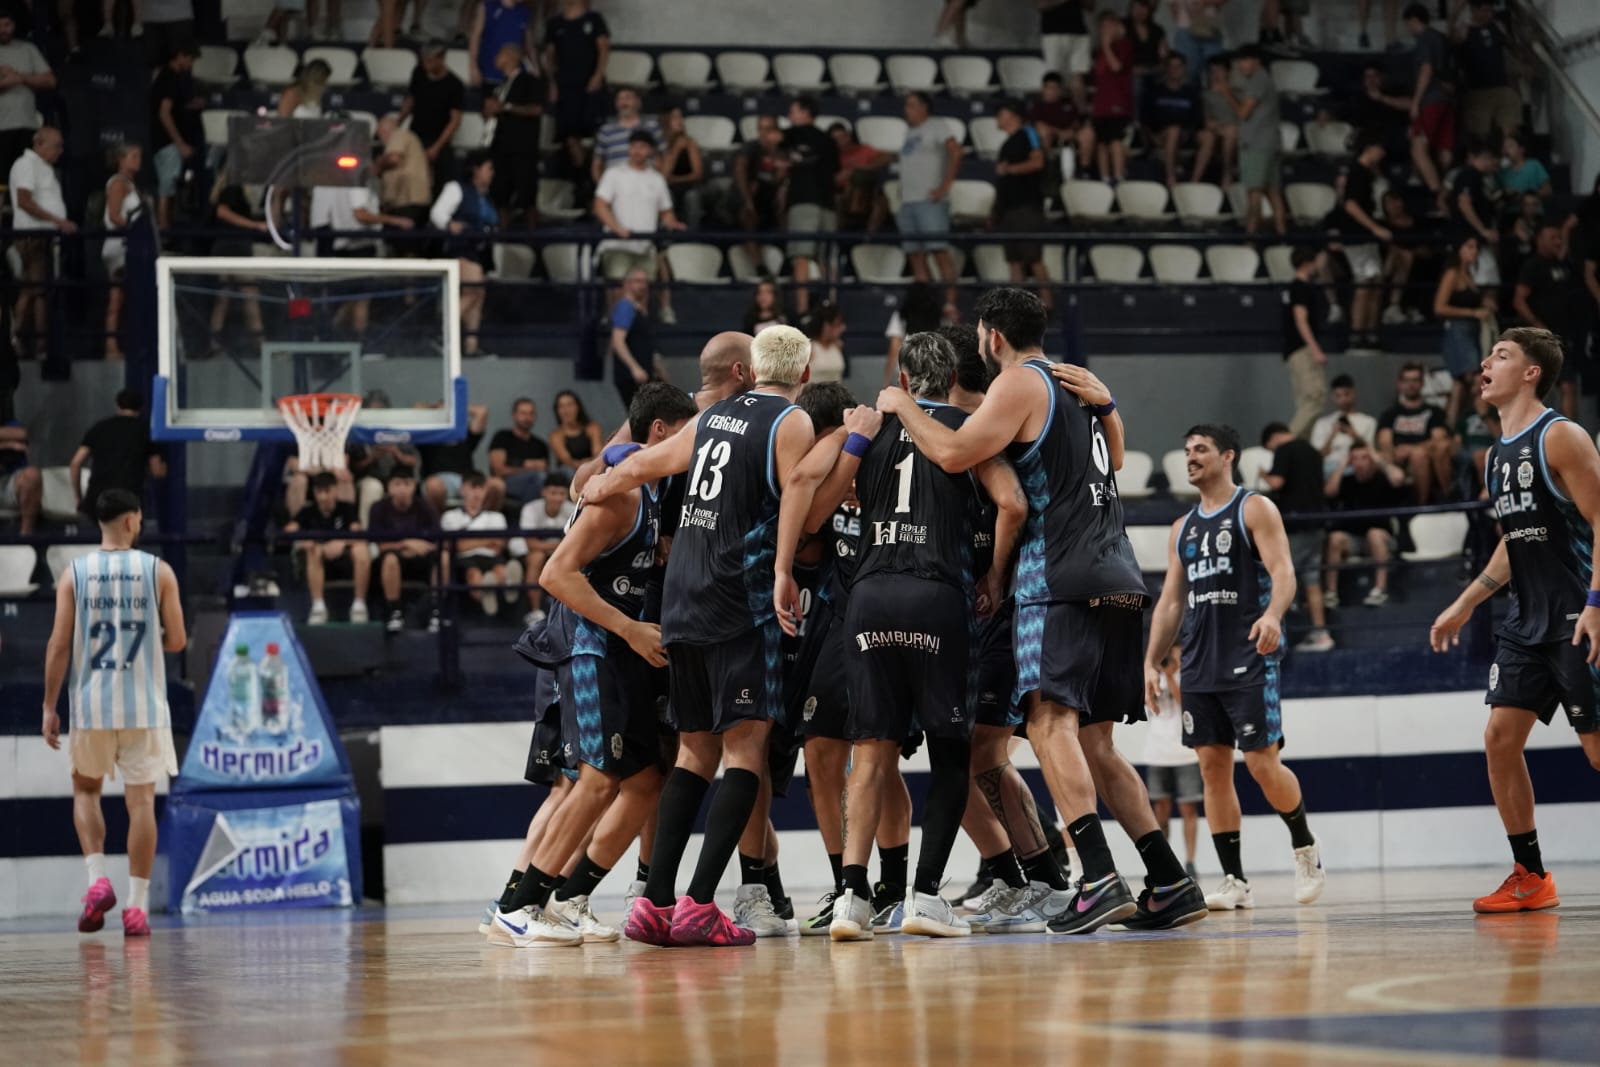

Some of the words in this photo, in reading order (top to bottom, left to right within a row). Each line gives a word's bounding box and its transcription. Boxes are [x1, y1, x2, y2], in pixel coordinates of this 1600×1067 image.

[706, 414, 749, 436] VERGARA
[688, 438, 732, 501] 13
[894, 452, 914, 513] 1
[1502, 462, 1511, 492] 2
[1200, 531, 1211, 557] 4
[90, 620, 146, 670] 27
[863, 631, 940, 650] TAMBURINI
